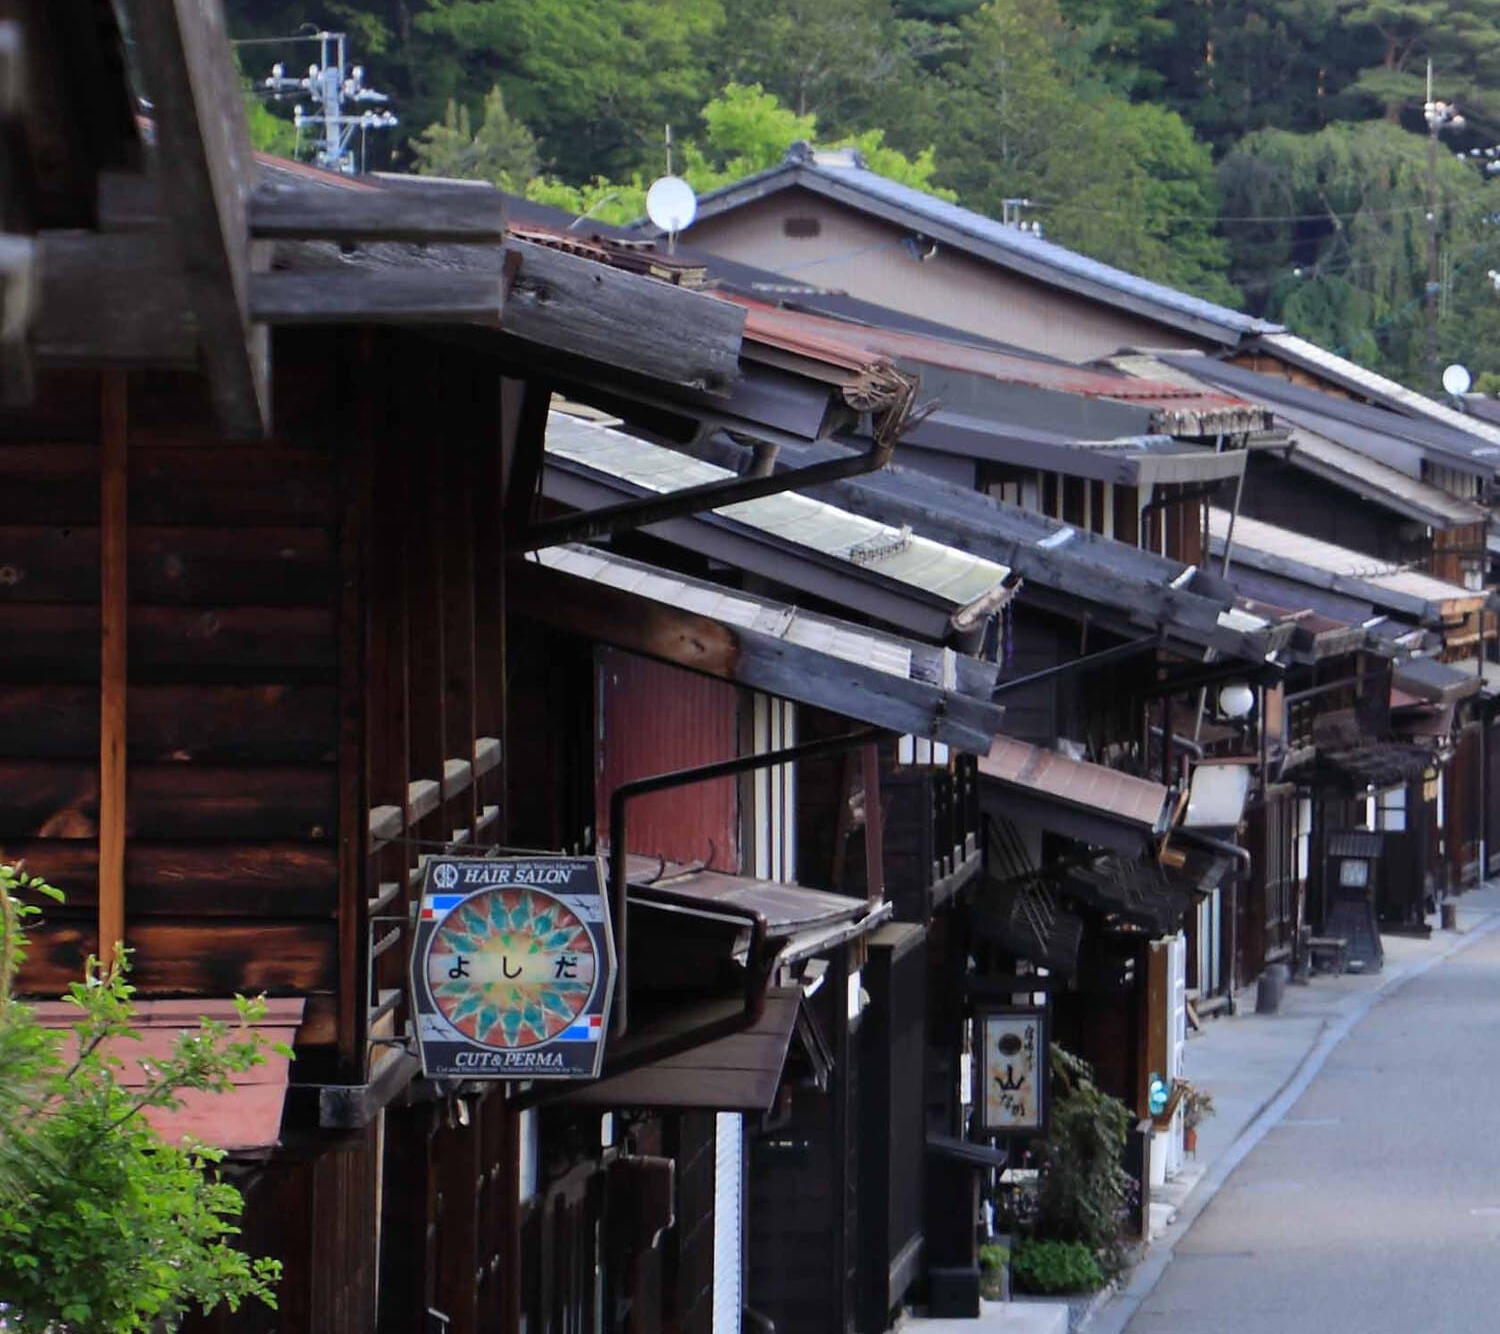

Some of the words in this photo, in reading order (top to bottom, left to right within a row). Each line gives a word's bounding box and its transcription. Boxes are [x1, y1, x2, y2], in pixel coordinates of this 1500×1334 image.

[464, 869, 511, 884] HAIR
[514, 869, 573, 884] SALON
[448, 955, 579, 979] よしだ
